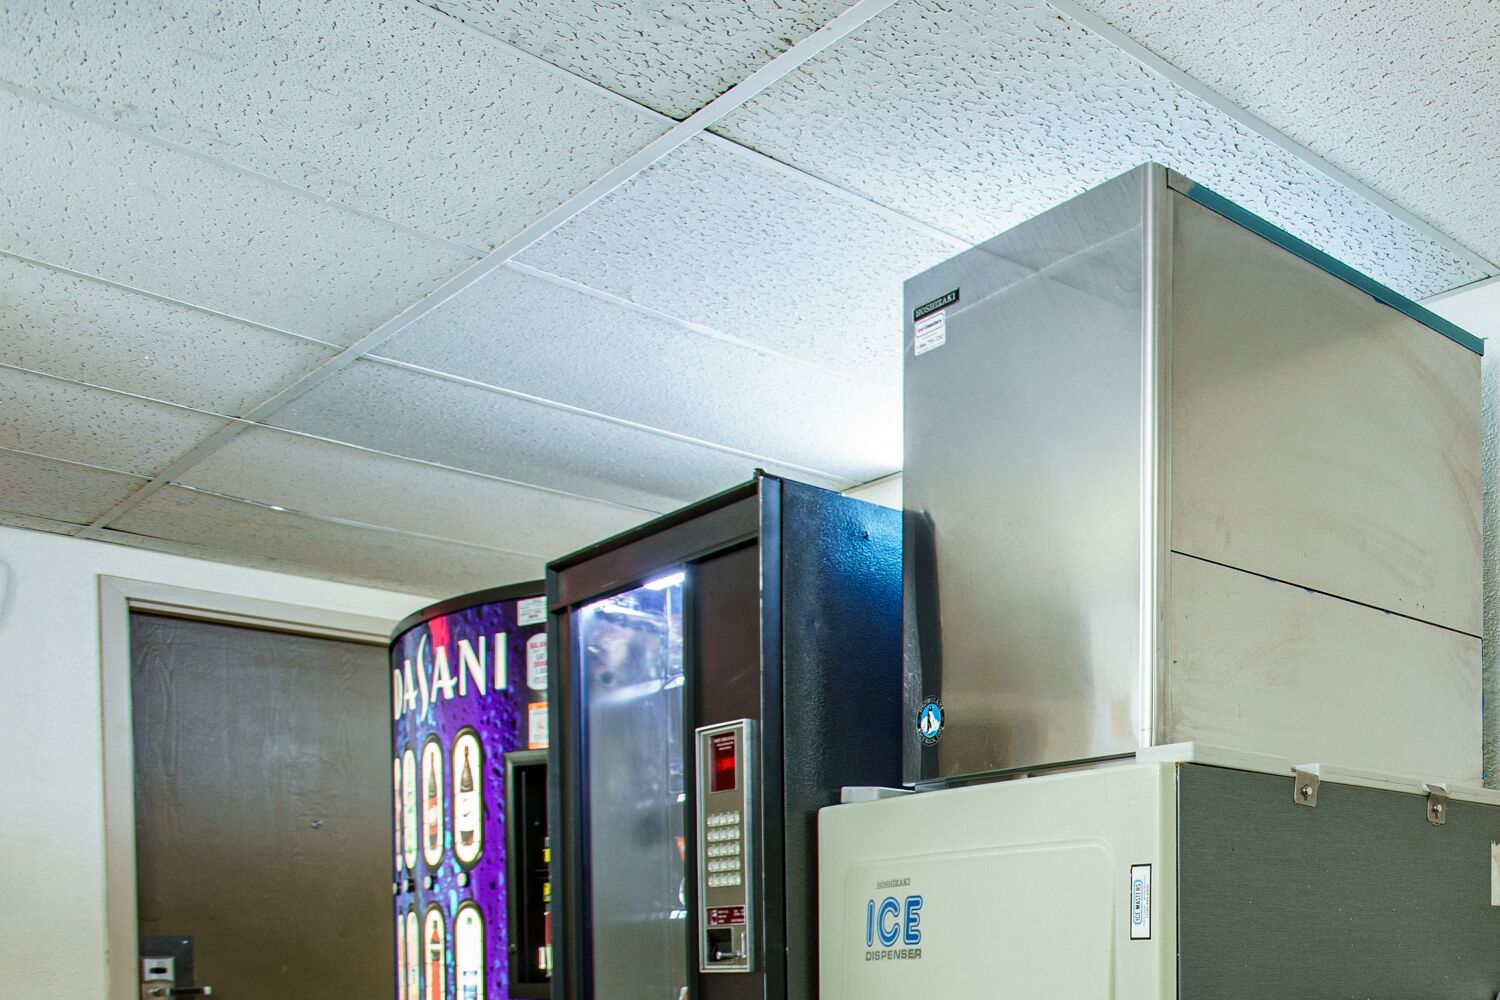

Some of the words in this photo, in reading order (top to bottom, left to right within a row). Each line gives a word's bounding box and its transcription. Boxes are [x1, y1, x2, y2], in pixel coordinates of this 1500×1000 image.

[393, 632, 508, 722] DASANI
[866, 895, 923, 947] ICE
[865, 948, 922, 961] DISPENSER
